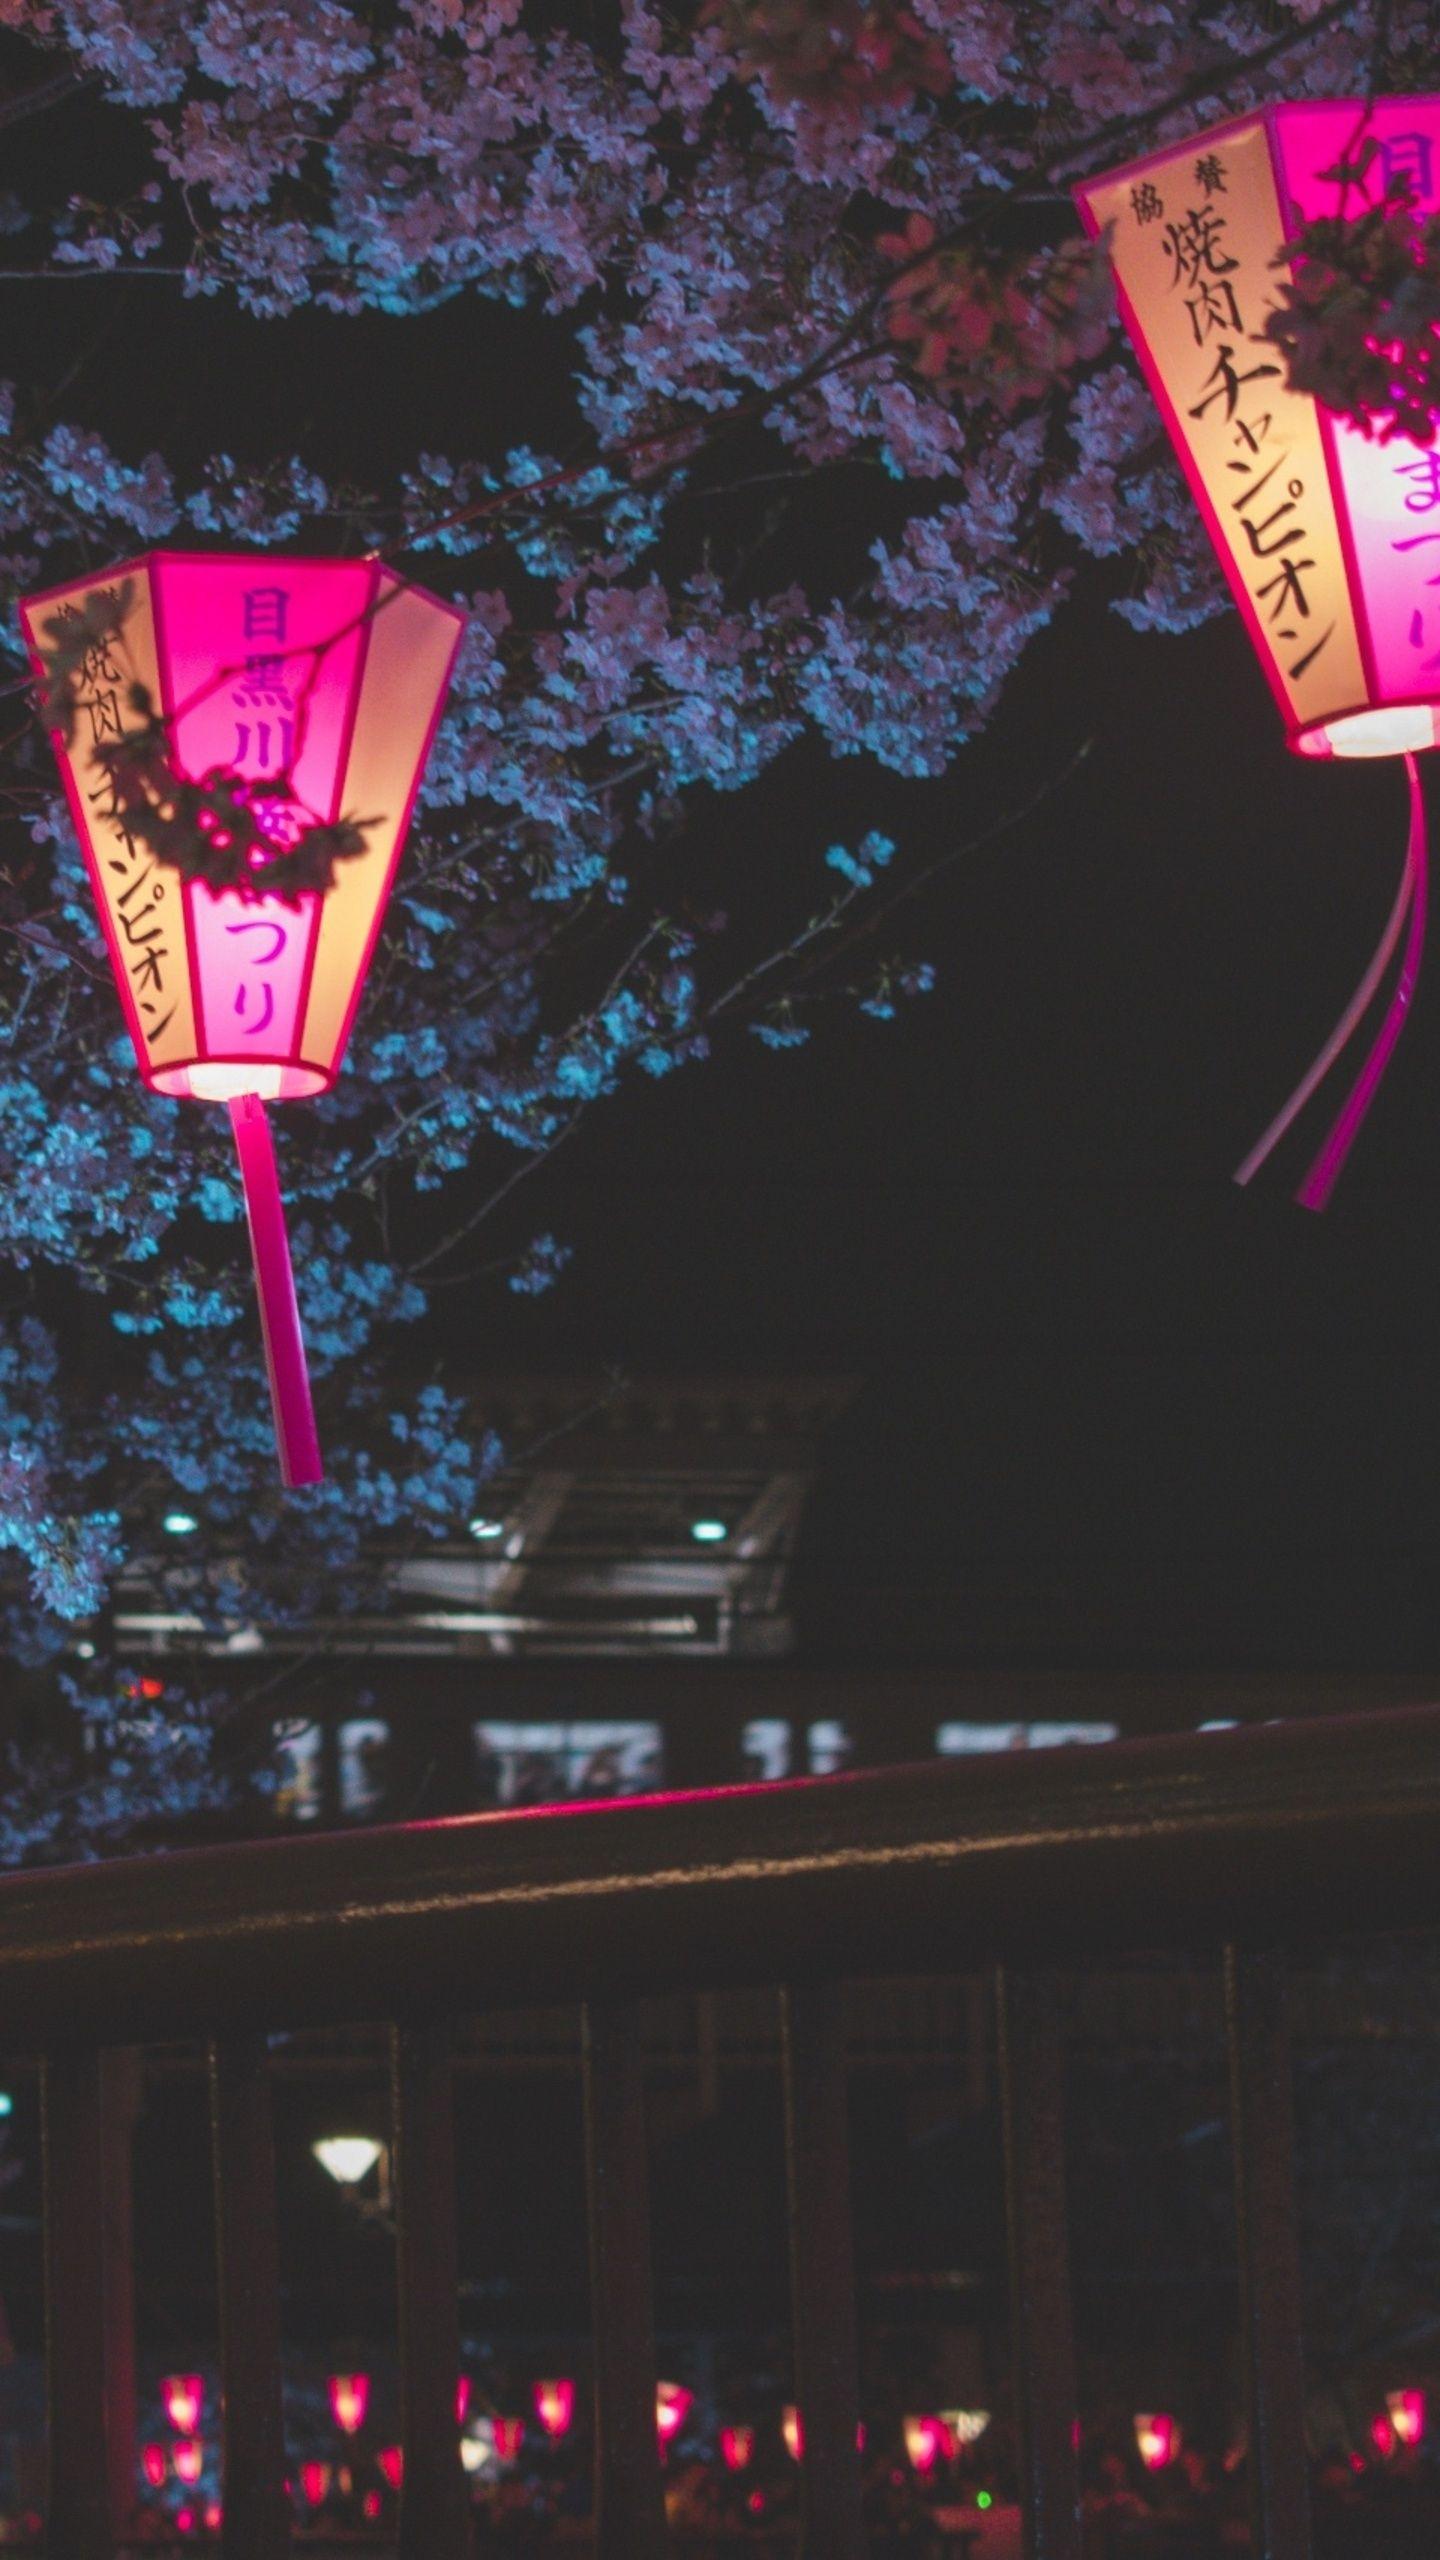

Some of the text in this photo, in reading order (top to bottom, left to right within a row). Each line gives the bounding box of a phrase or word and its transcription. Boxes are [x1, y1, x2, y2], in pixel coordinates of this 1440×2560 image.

[1162, 206, 1336, 680] 焼肉チャンピオン
[226, 585, 294, 1034] 目黒川つり
